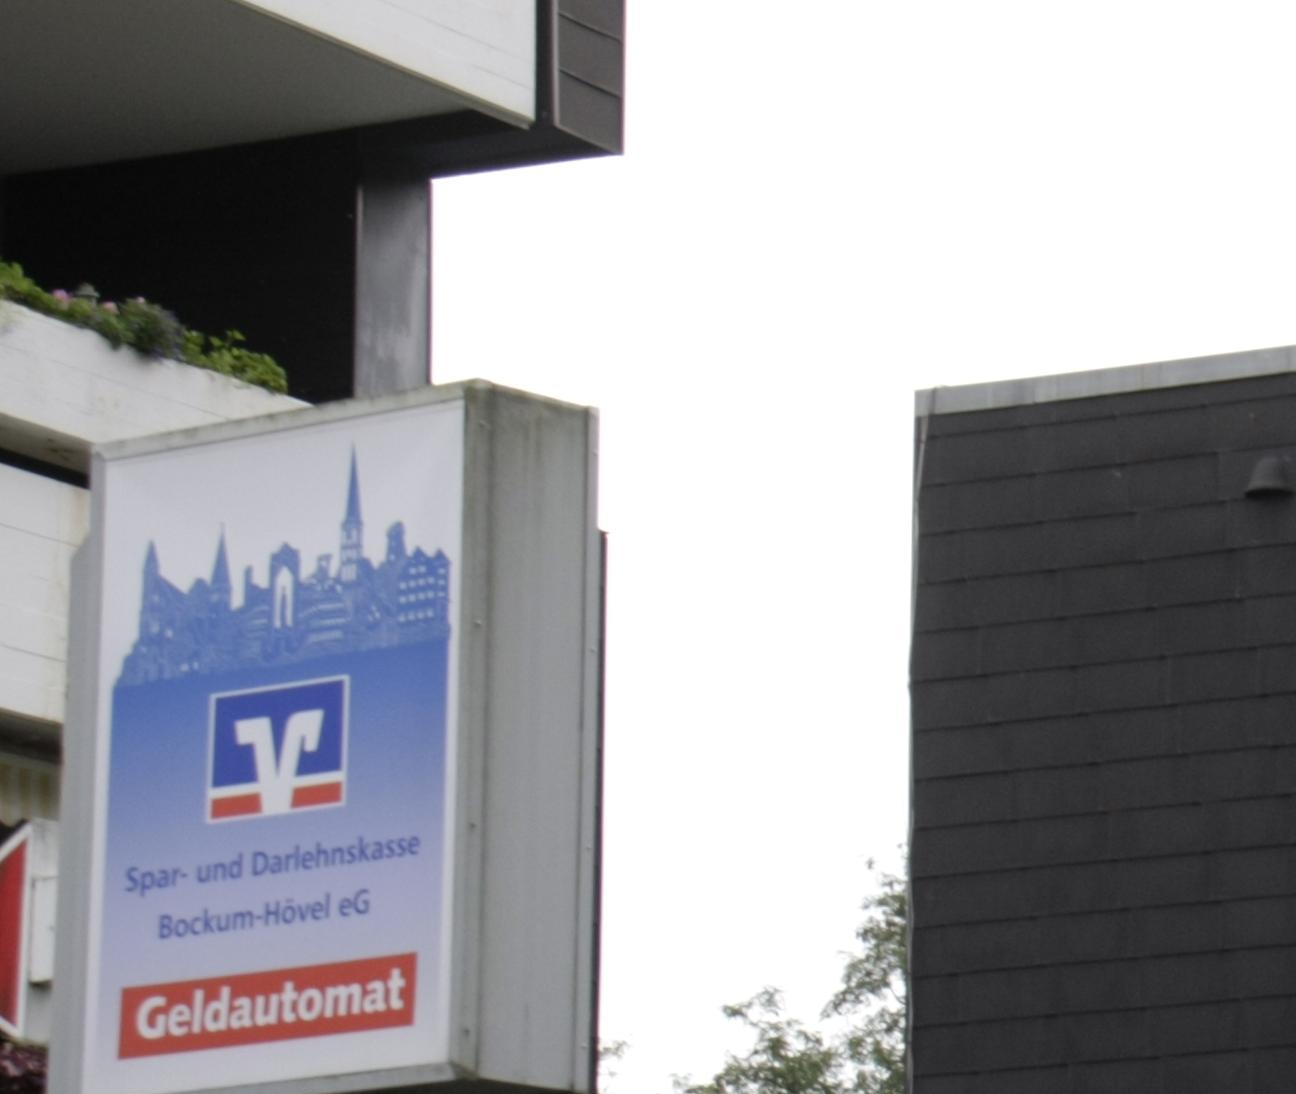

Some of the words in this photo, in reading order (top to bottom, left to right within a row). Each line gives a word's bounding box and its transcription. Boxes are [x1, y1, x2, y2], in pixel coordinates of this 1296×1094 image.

[125, 866, 187, 897] Spar-
[196, 853, 243, 884] und
[252, 835, 421, 877] Darlehnskasse
[157, 892, 331, 940] Bockum-Hövel
[339, 888, 371, 918] eG
[135, 967, 407, 1042] Geldautomat
